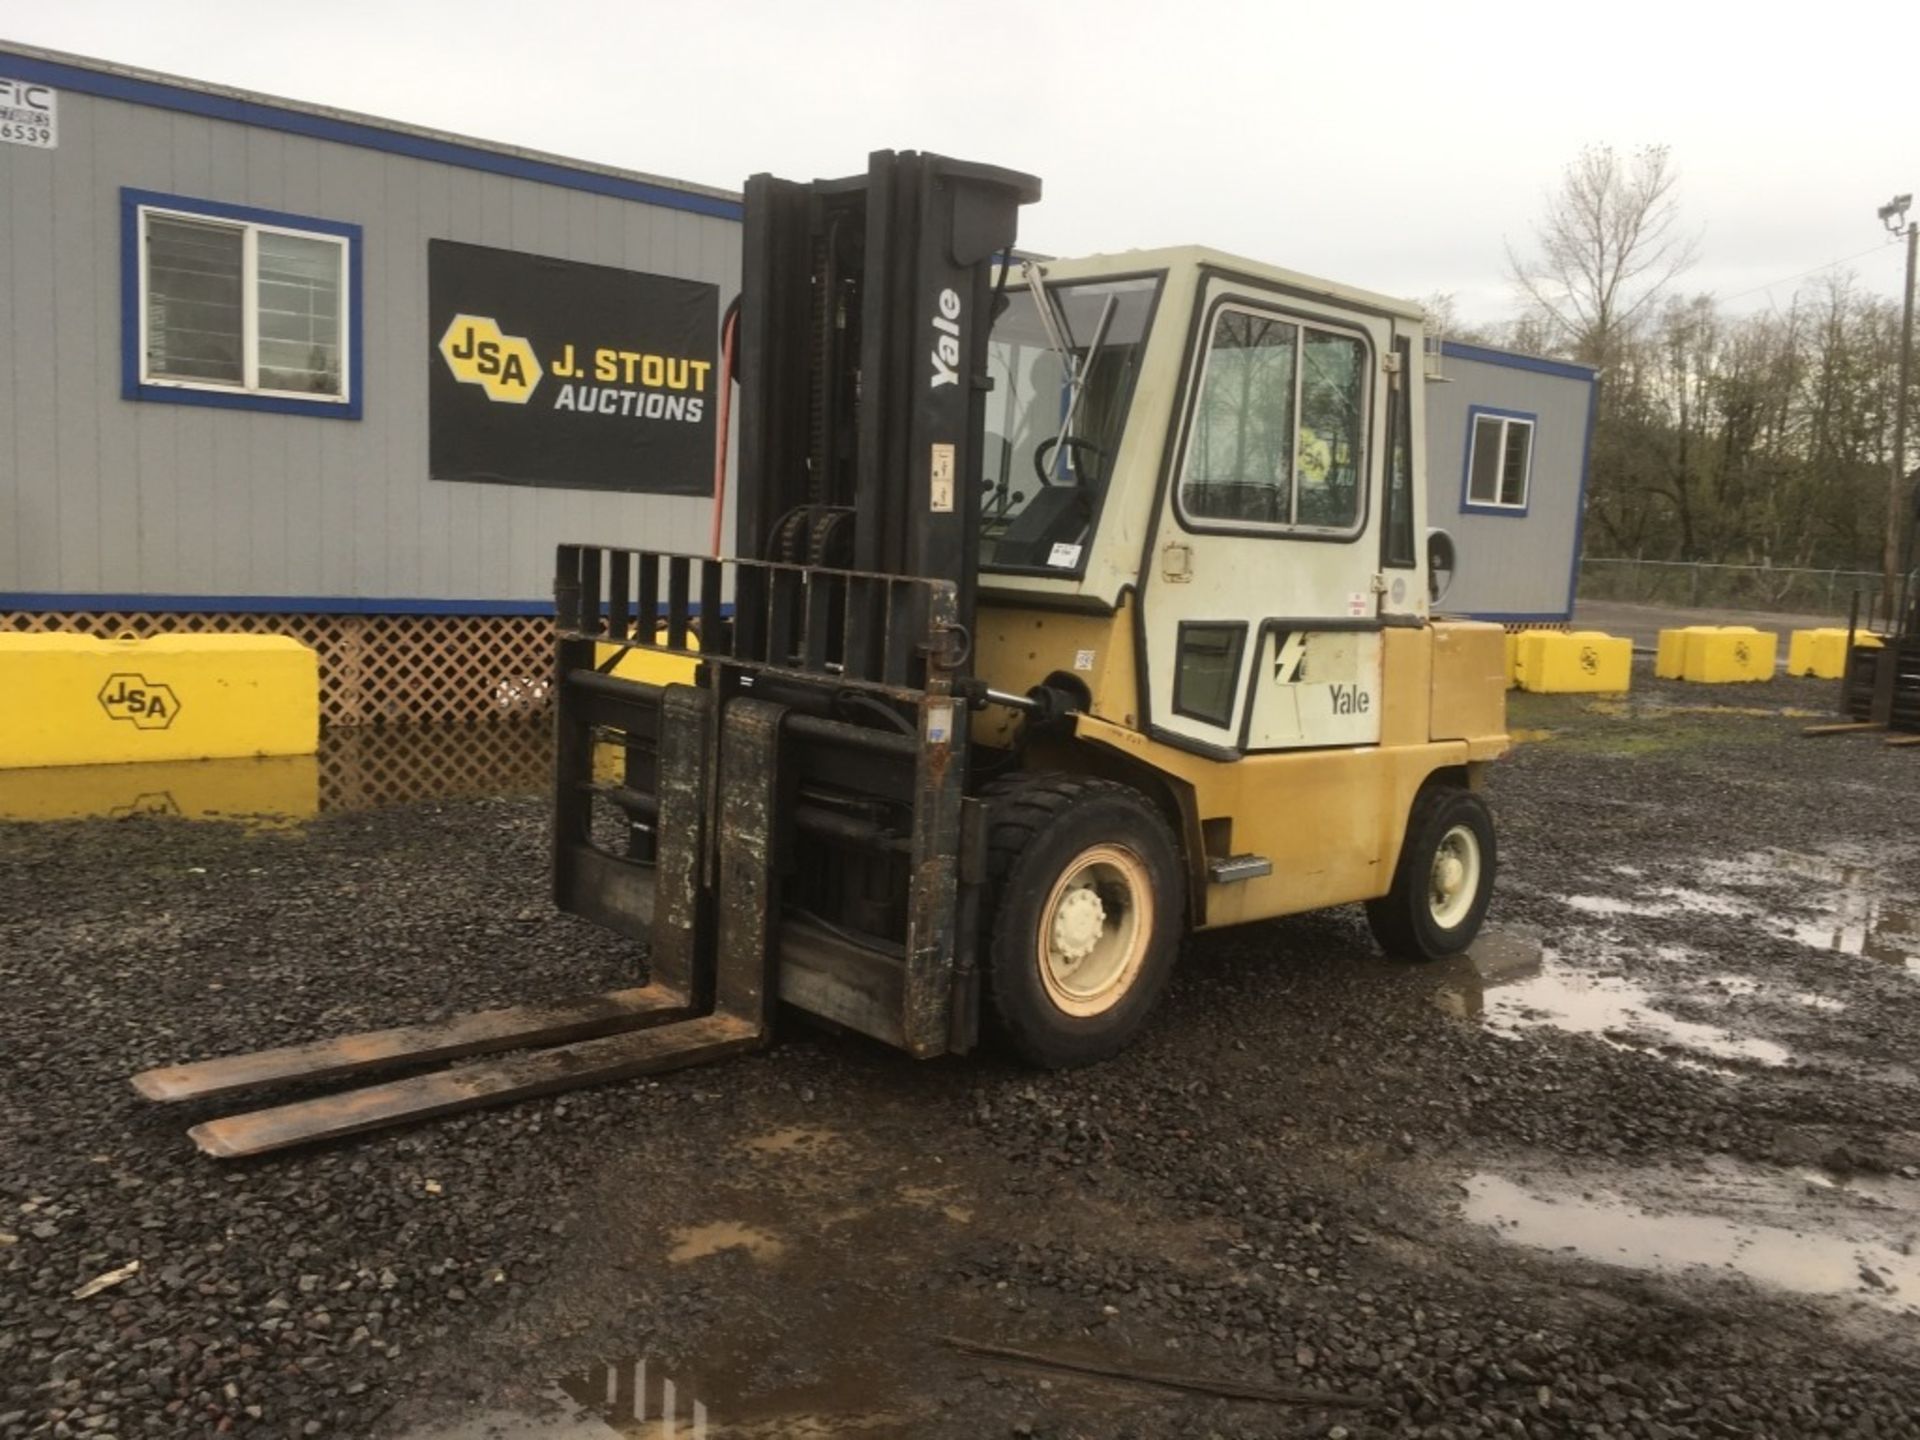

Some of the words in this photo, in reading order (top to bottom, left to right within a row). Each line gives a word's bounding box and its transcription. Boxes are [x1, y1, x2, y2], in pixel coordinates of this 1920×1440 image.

[452, 327, 527, 388] JSA
[931, 288, 961, 388] Yale
[552, 344, 584, 378] J.
[594, 348, 711, 392] STOUT
[554, 384, 704, 423] AUCTIONS
[107, 682, 167, 719] JSA
[1329, 683, 1370, 715] Yale
